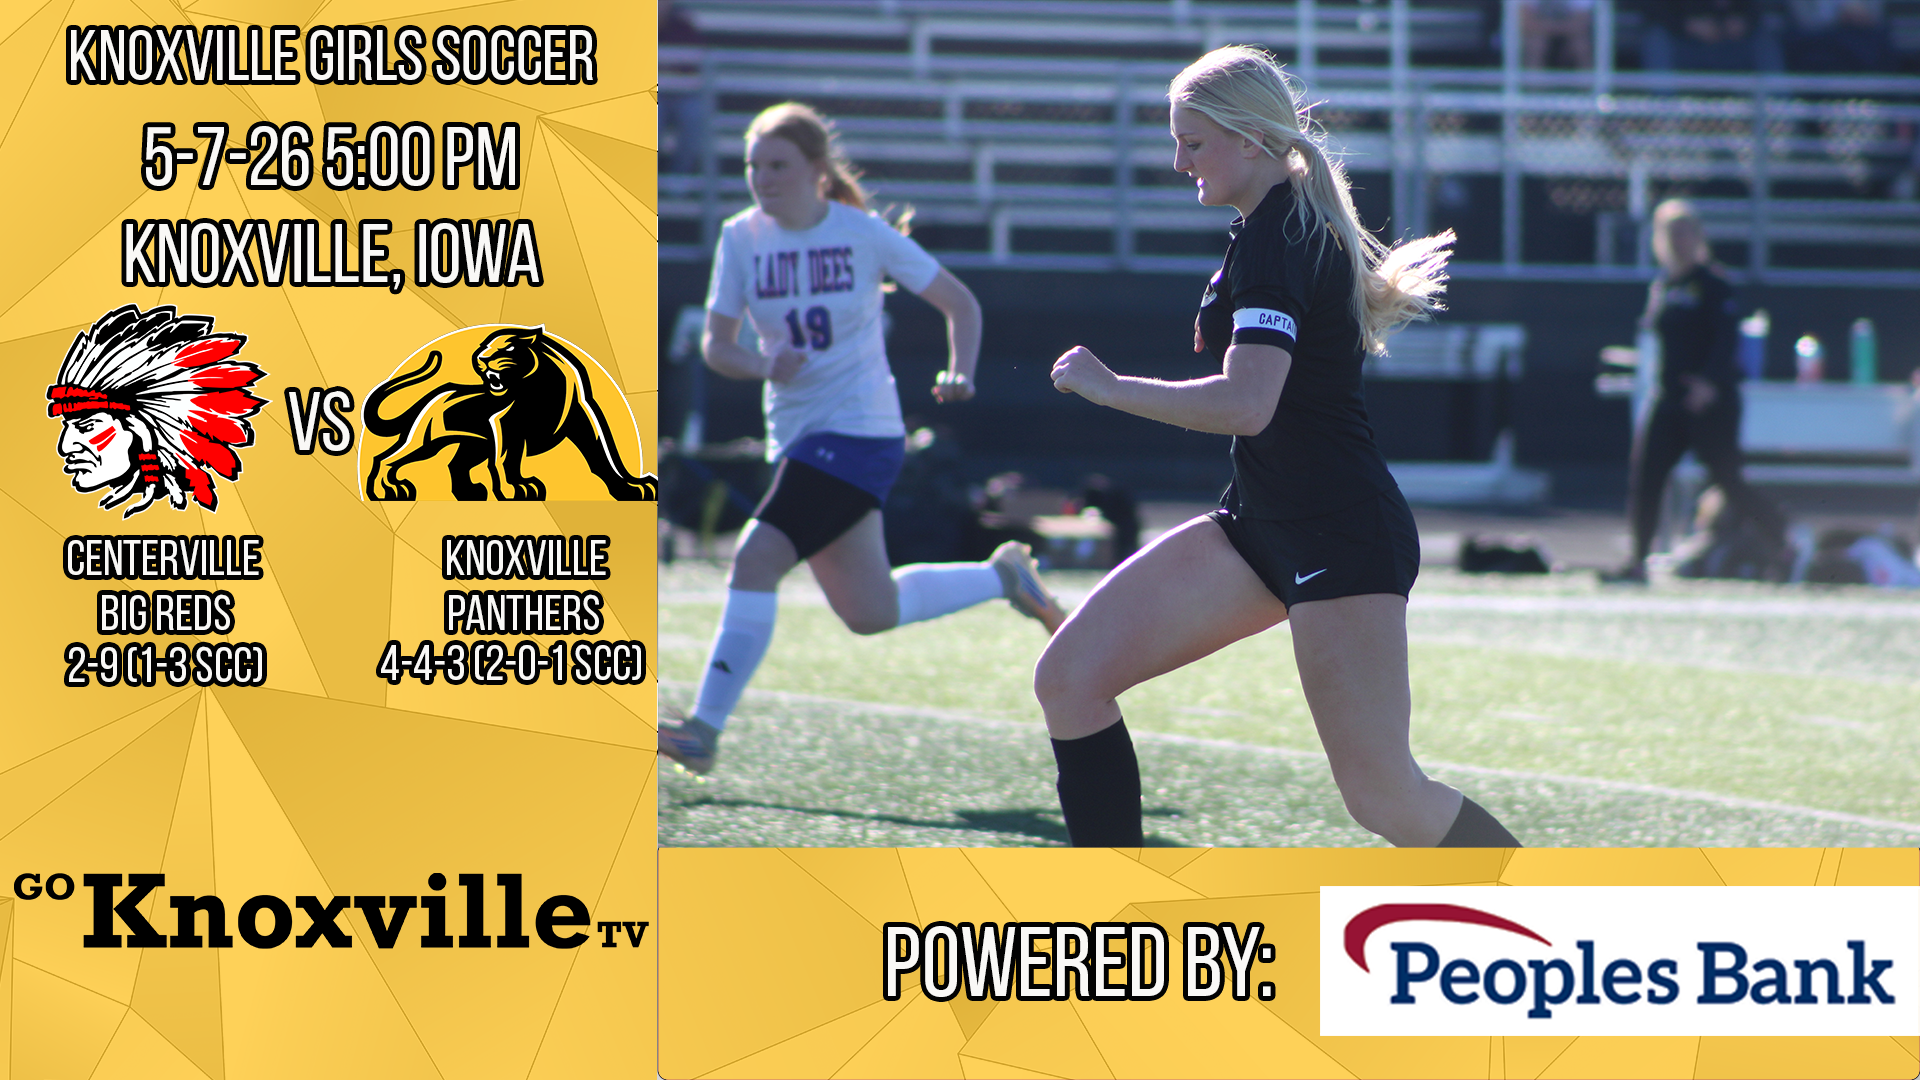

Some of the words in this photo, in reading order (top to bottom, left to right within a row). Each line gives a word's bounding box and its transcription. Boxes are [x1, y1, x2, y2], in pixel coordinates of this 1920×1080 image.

[755, 250, 799, 299] LADY
[807, 246, 855, 296] DEES
[784, 305, 832, 351] 19
